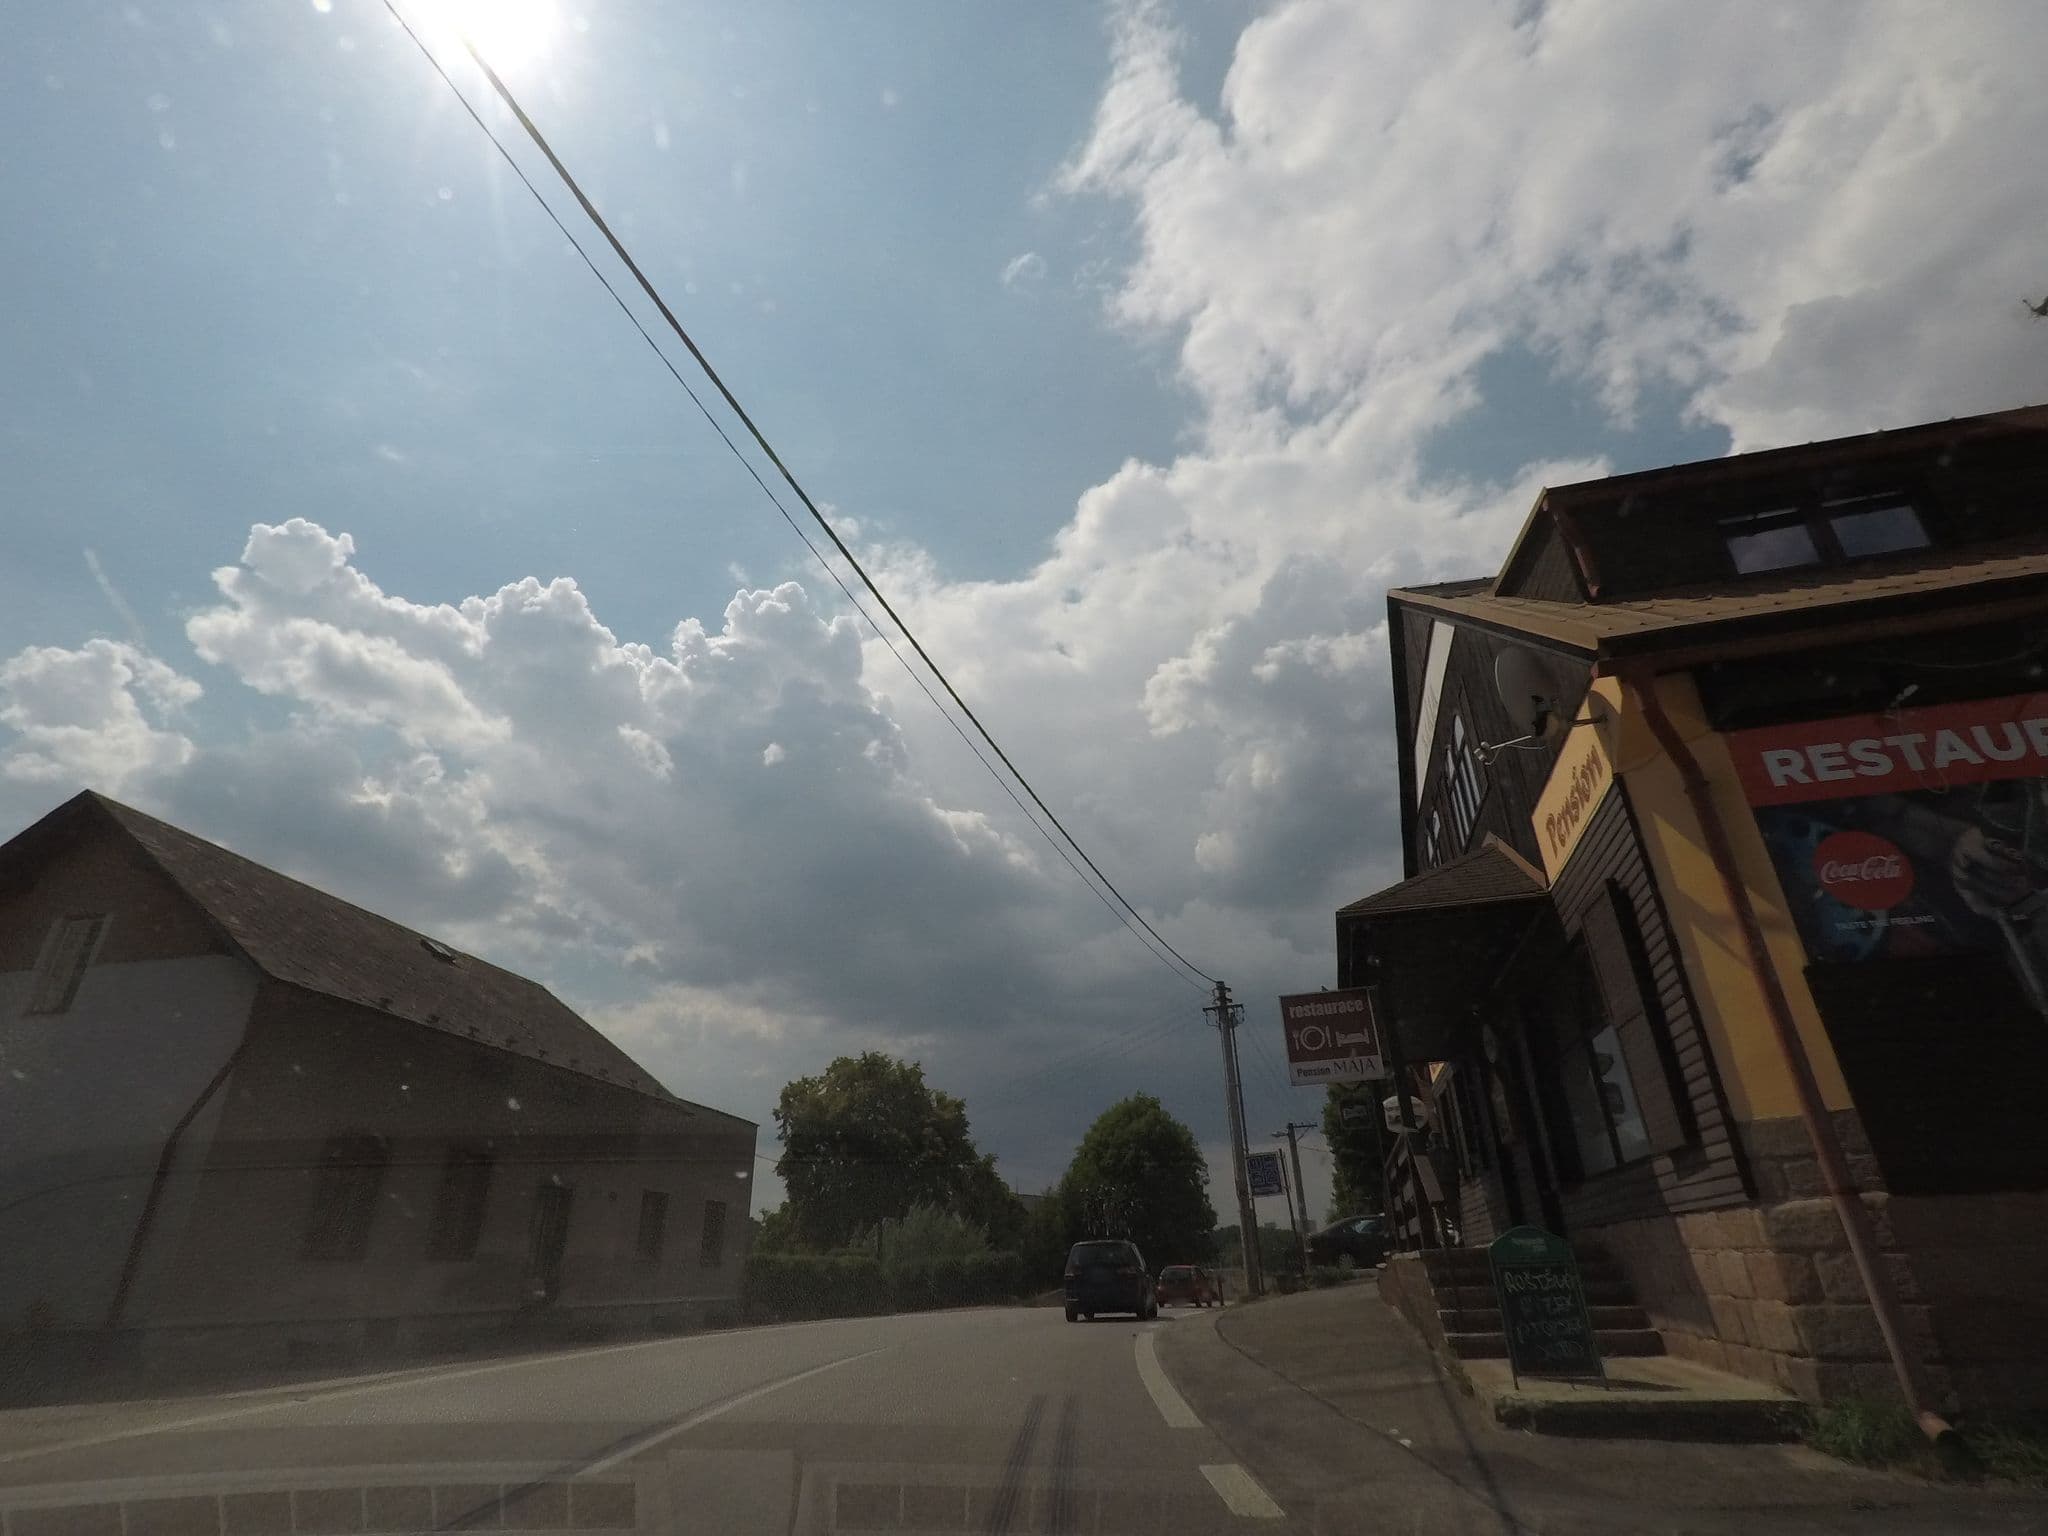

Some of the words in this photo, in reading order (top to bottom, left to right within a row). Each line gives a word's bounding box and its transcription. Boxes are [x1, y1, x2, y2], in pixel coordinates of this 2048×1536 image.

[1545, 744, 1603, 859] Pension
[1820, 855, 1900, 884] Coca-Cola
[1288, 999, 1365, 1019] restaurace
[1297, 1067, 1331, 1078] Pension
